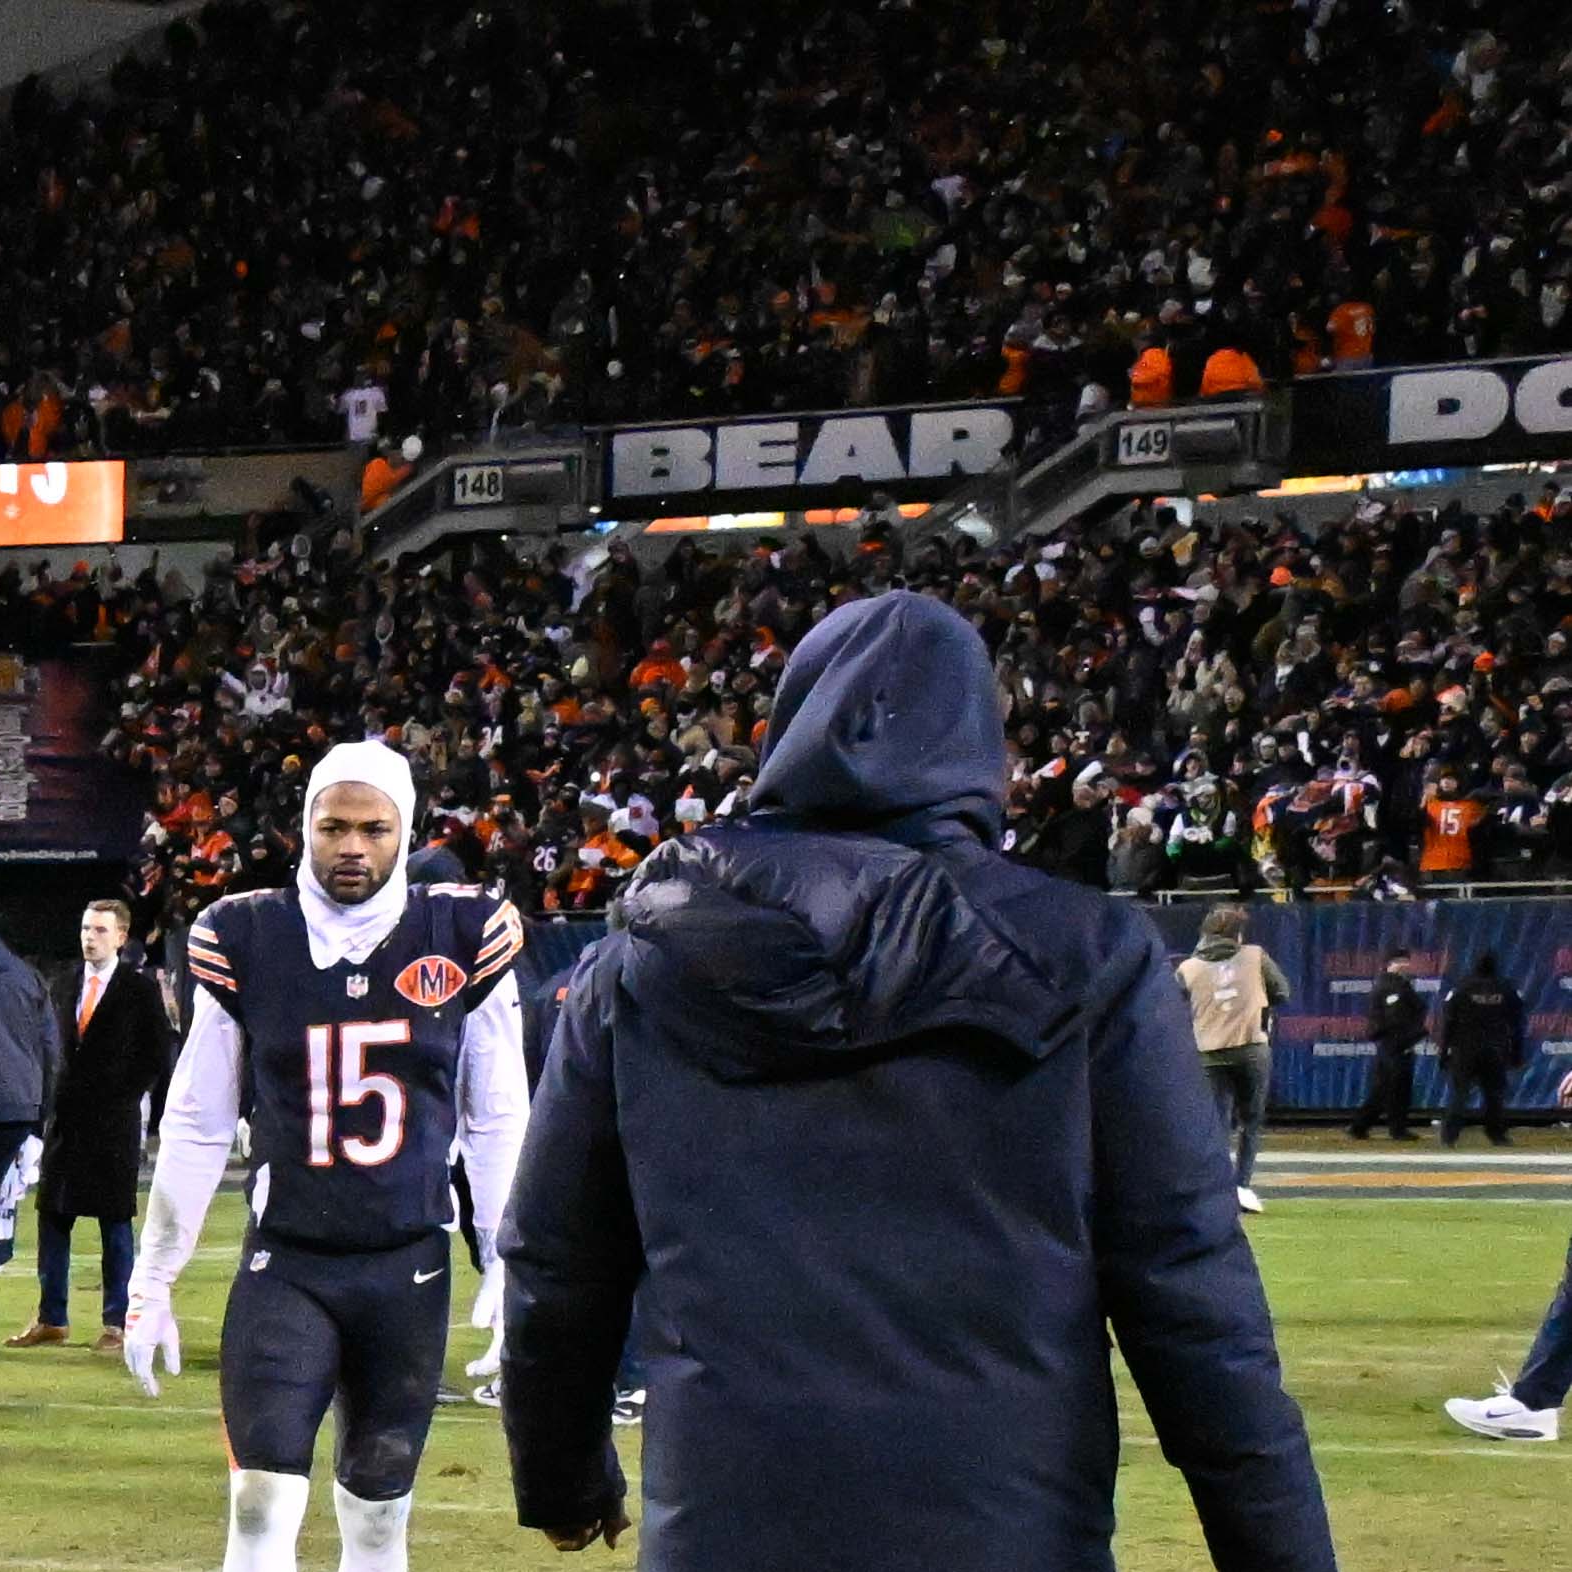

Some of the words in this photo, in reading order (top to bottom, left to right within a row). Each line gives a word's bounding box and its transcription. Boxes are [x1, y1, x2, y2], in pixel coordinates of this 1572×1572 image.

[612, 408, 1013, 498] BEAR
[1122, 429, 1168, 459] 149
[457, 472, 500, 498] 148
[1439, 807, 1462, 836] 15
[532, 845, 558, 873] 26
[307, 1018, 410, 1167] 15
